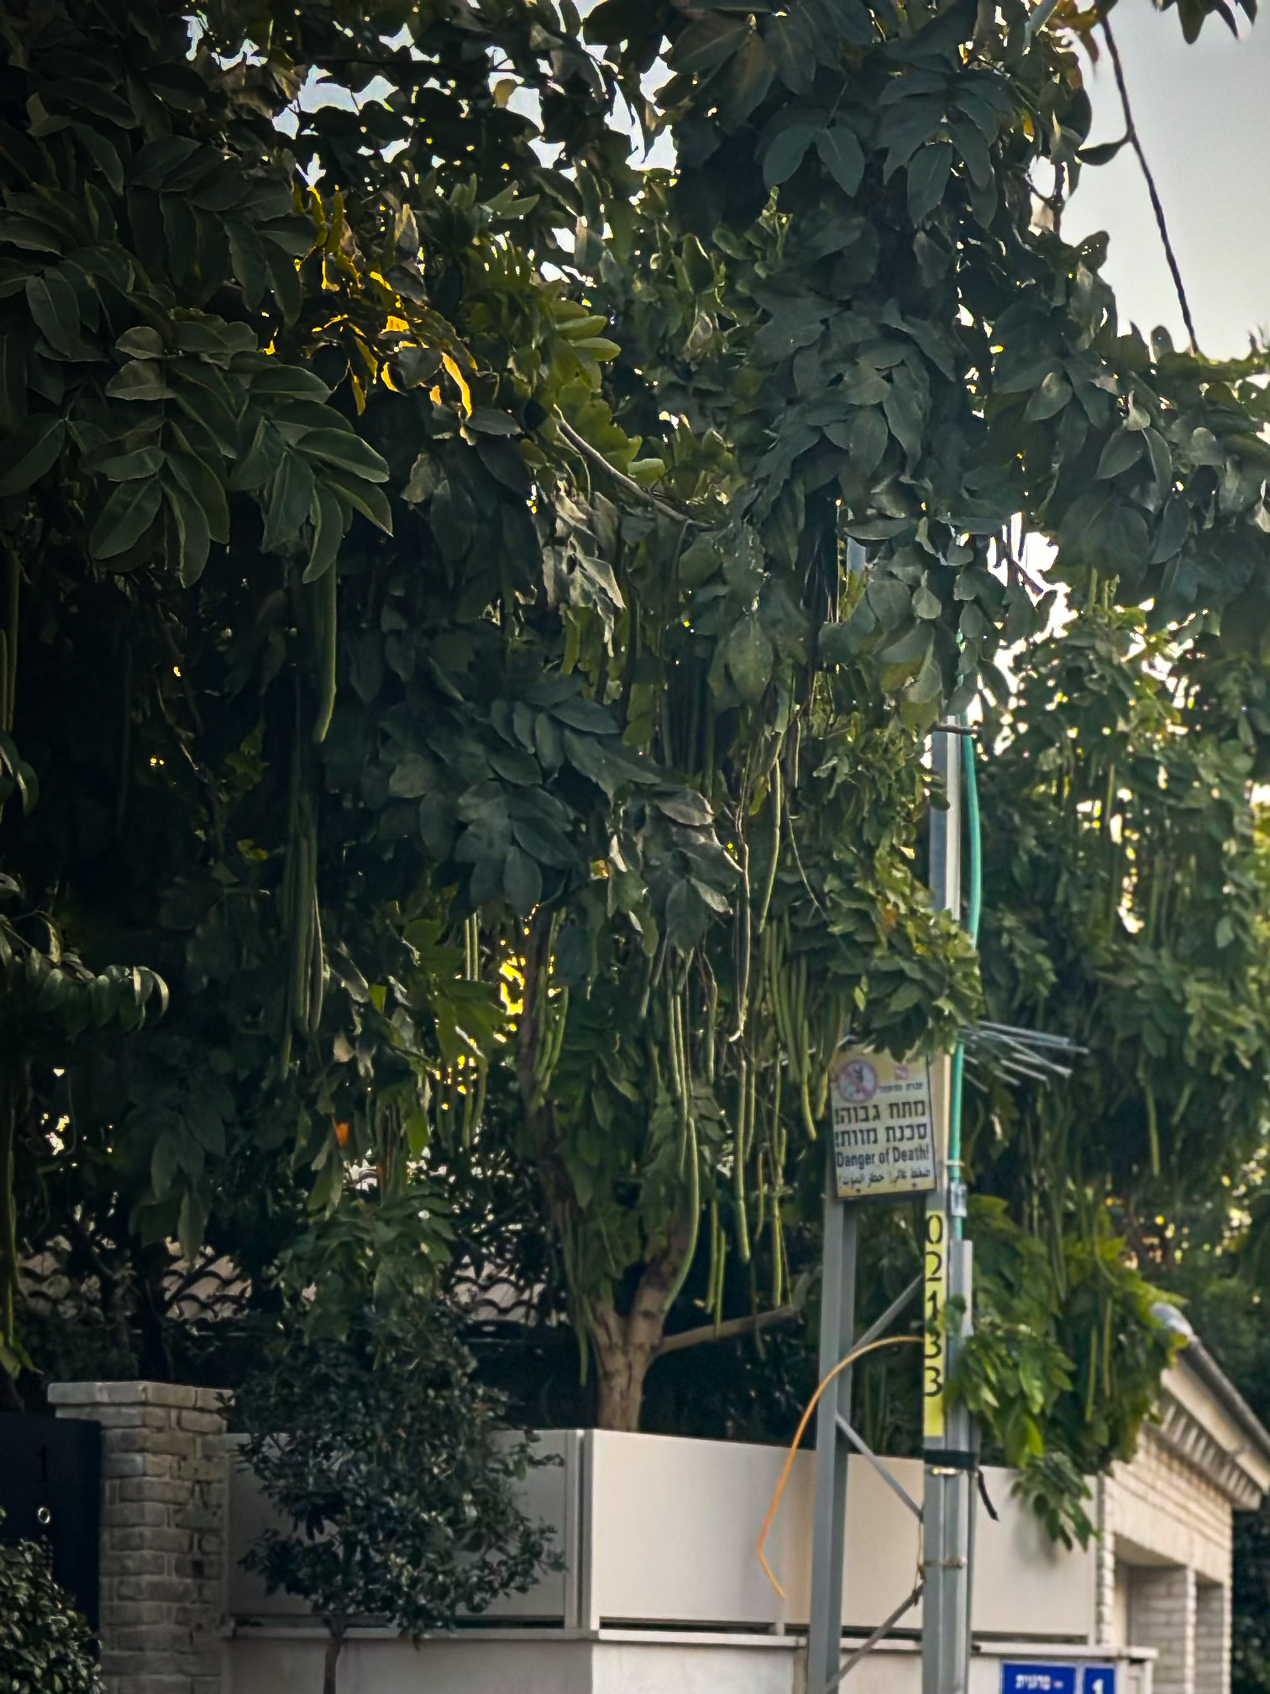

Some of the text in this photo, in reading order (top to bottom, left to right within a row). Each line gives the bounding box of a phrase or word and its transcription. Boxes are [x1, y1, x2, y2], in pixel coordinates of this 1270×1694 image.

[835, 1100, 926, 1125] מתח גבוה!
[835, 1123, 928, 1148] סכנת מוות!
[837, 1144, 930, 1170] Danger of Death!
[924, 1214, 944, 1397] 02133
